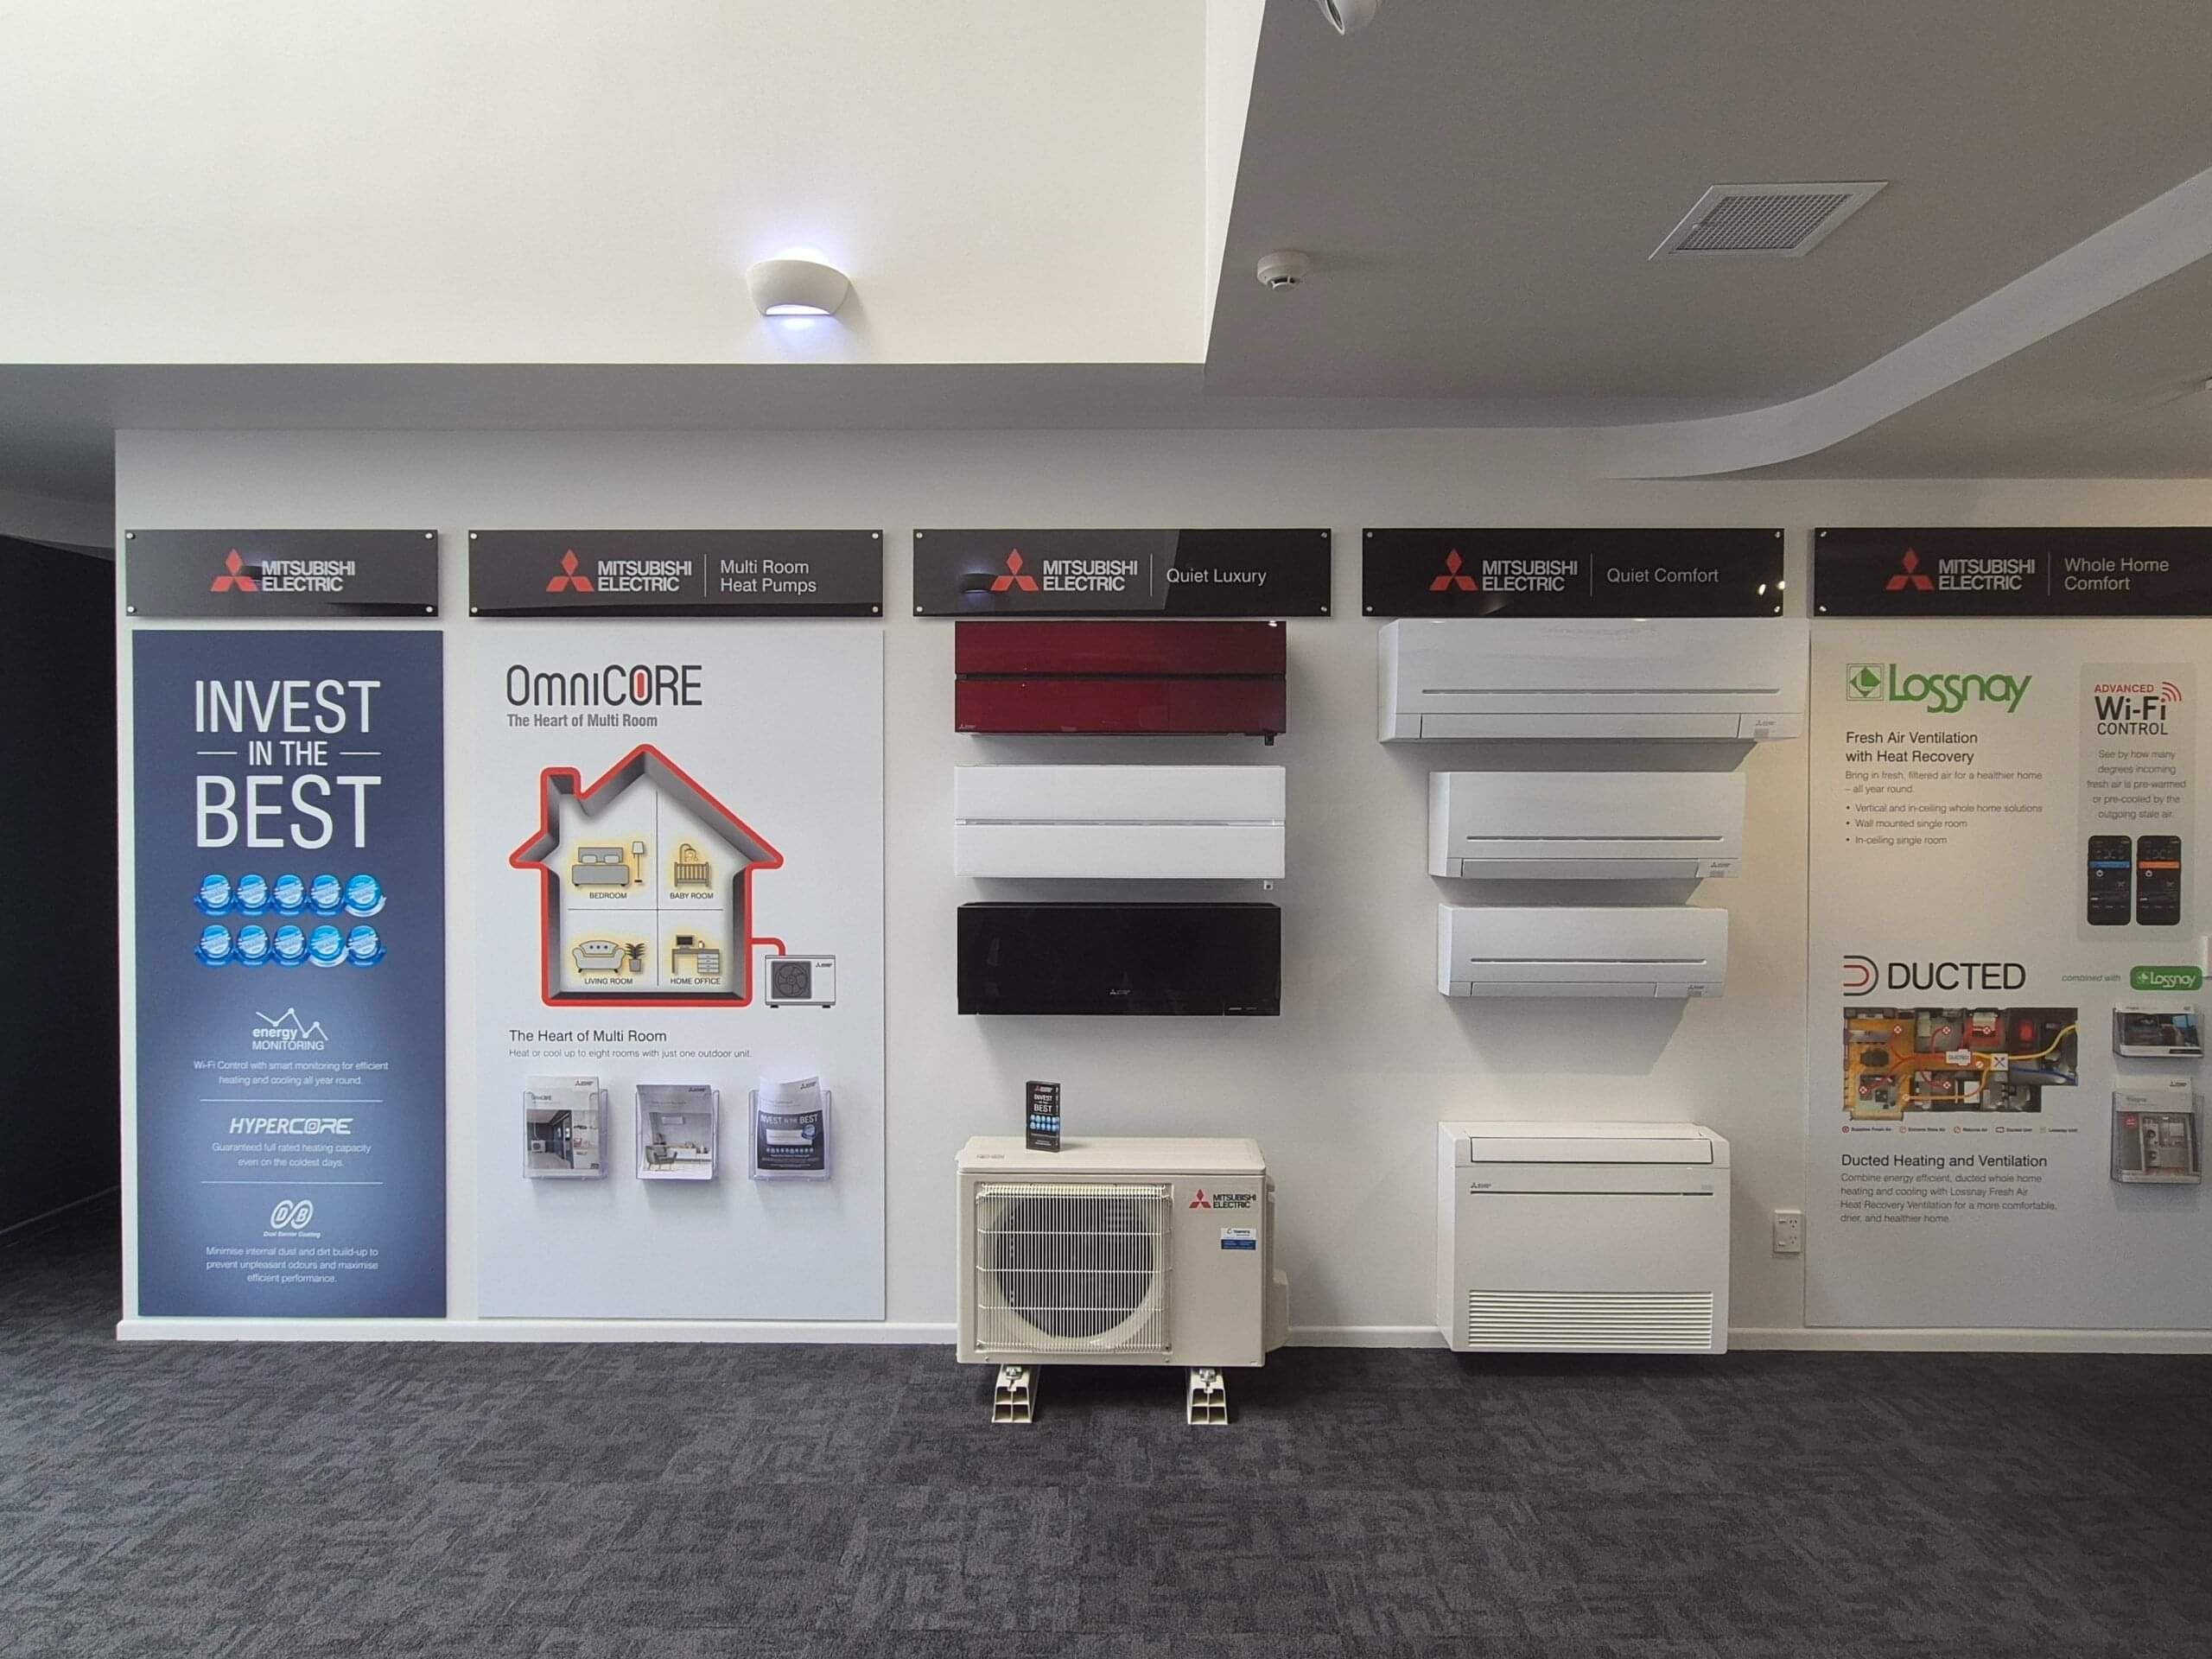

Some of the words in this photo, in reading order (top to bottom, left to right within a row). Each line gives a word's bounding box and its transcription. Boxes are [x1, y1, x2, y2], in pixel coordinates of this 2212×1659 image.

[262, 560, 355, 575] MITSUBISHI
[598, 561, 691, 575] MITSUBISHI
[721, 560, 757, 574] Multi
[763, 560, 809, 574] Room
[1044, 560, 1137, 575] MITSUBISHI
[1483, 560, 1577, 575] MITSUBISHI
[1939, 559, 2035, 574] MITSUBISHI
[2064, 558, 2115, 571] Whole
[2121, 557, 2169, 571] Home
[1166, 568, 1208, 583] Quiet
[1214, 569, 1266, 586] Luxury
[1607, 568, 1649, 582] Quiet
[1655, 569, 1719, 582] Comfort
[262, 576, 343, 592] ELECTRIC
[599, 576, 679, 591] ELECTRIC
[721, 578, 757, 592] Heat
[763, 578, 816, 595] Pumps
[1044, 576, 1125, 591] ELECTRIC
[1483, 576, 1565, 591] ELECTRIC
[1939, 575, 2022, 590] ELECTRIC
[2065, 576, 2130, 590] Comfort
[507, 664, 702, 706] OmniCORE
[1889, 664, 2032, 714] Lossnay
[2094, 684, 2154, 694] ADVANCED
[196, 680, 380, 734] INVEST
[2094, 696, 2166, 721] Wi-Fi
[507, 714, 530, 727] The
[534, 714, 568, 727] Heart
[572, 714, 583, 727] of
[588, 714, 619, 727] Multi
[623, 714, 657, 727] Room
[2097, 722, 2169, 735] CONTROL
[1847, 732, 1883, 743] Fresh
[1887, 732, 1905, 743] Air
[1909, 732, 1977, 743] Ventilation
[250, 741, 271, 766] IN
[280, 741, 327, 766] THE
[1846, 750, 1872, 762] with
[1878, 750, 1908, 762] Heat
[1912, 751, 1974, 765] Recovery
[2152, 752, 2176, 760] many
[1846, 771, 1869, 781] Bring
[1865, 786, 1885, 795] year
[197, 774, 381, 849] BEST
[1855, 804, 1886, 812] Vertical
[1908, 804, 1947, 814] in-ceiling
[1949, 804, 1974, 812] whole
[2004, 804, 2043, 813] solutions
[1855, 819, 1873, 828] Wall
[1876, 819, 1914, 828] mounted
[1917, 819, 1942, 830] single
[1855, 836, 1894, 846] In-ceiling
[1897, 836, 1922, 846] single
[1888, 963, 2025, 990] DUCTED
[2151, 971, 2196, 988] Lossnay
[253, 1028, 298, 1040] energy
[509, 1030, 533, 1041] The
[538, 1030, 573, 1041] Heart
[577, 1030, 589, 1041] of
[594, 1030, 623, 1041] Multi
[628, 1030, 666, 1041] Room
[252, 1040, 325, 1051] MONITORING
[508, 1049, 529, 1058] Heat
[543, 1049, 561, 1058] cool
[564, 1051, 575, 1059] up
[589, 1049, 609, 1060] eight
[663, 1050, 677, 1059] just
[194, 1061, 215, 1070] Wi-Fi
[217, 1060, 248, 1070] Control
[251, 1061, 267, 1070] with
[270, 1062, 293, 1071] smart
[295, 1061, 340, 1072] monitoring
[355, 1061, 389, 1071] efficient
[229, 1118, 353, 1135] HYPERCORE
[1842, 1154, 1889, 1166] Ducted
[1894, 1154, 1944, 1169] Heating
[1949, 1154, 1974, 1166] and
[1979, 1154, 2047, 1166] Ventilation
[1840, 1173, 1881, 1183] Combine
[1883, 1175, 1914, 1184] energy
[2017, 1174, 2042, 1183] home
[1840, 1187, 1873, 1197] heating
[1895, 1186, 1928, 1198] cooling
[1929, 1187, 1948, 1197] with
[1950, 1187, 1986, 1198] Lossnay
[1989, 1187, 2014, 1196] Fresh
[1840, 1200, 1861, 1209] Heat
[1864, 1200, 1904, 1211] Recovery
[1907, 1201, 1952, 1210] Ventilation
[206, 1247, 244, 1256] Minimise
[246, 1247, 276, 1256] internal
[278, 1247, 297, 1256] dust
[334, 1247, 368, 1257] build-up
[207, 1261, 238, 1270] prevent
[241, 1260, 286, 1270] unpleasant
[289, 1260, 317, 1269] odours
[339, 1261, 378, 1270] maximise
[248, 1273, 279, 1282] efficient
